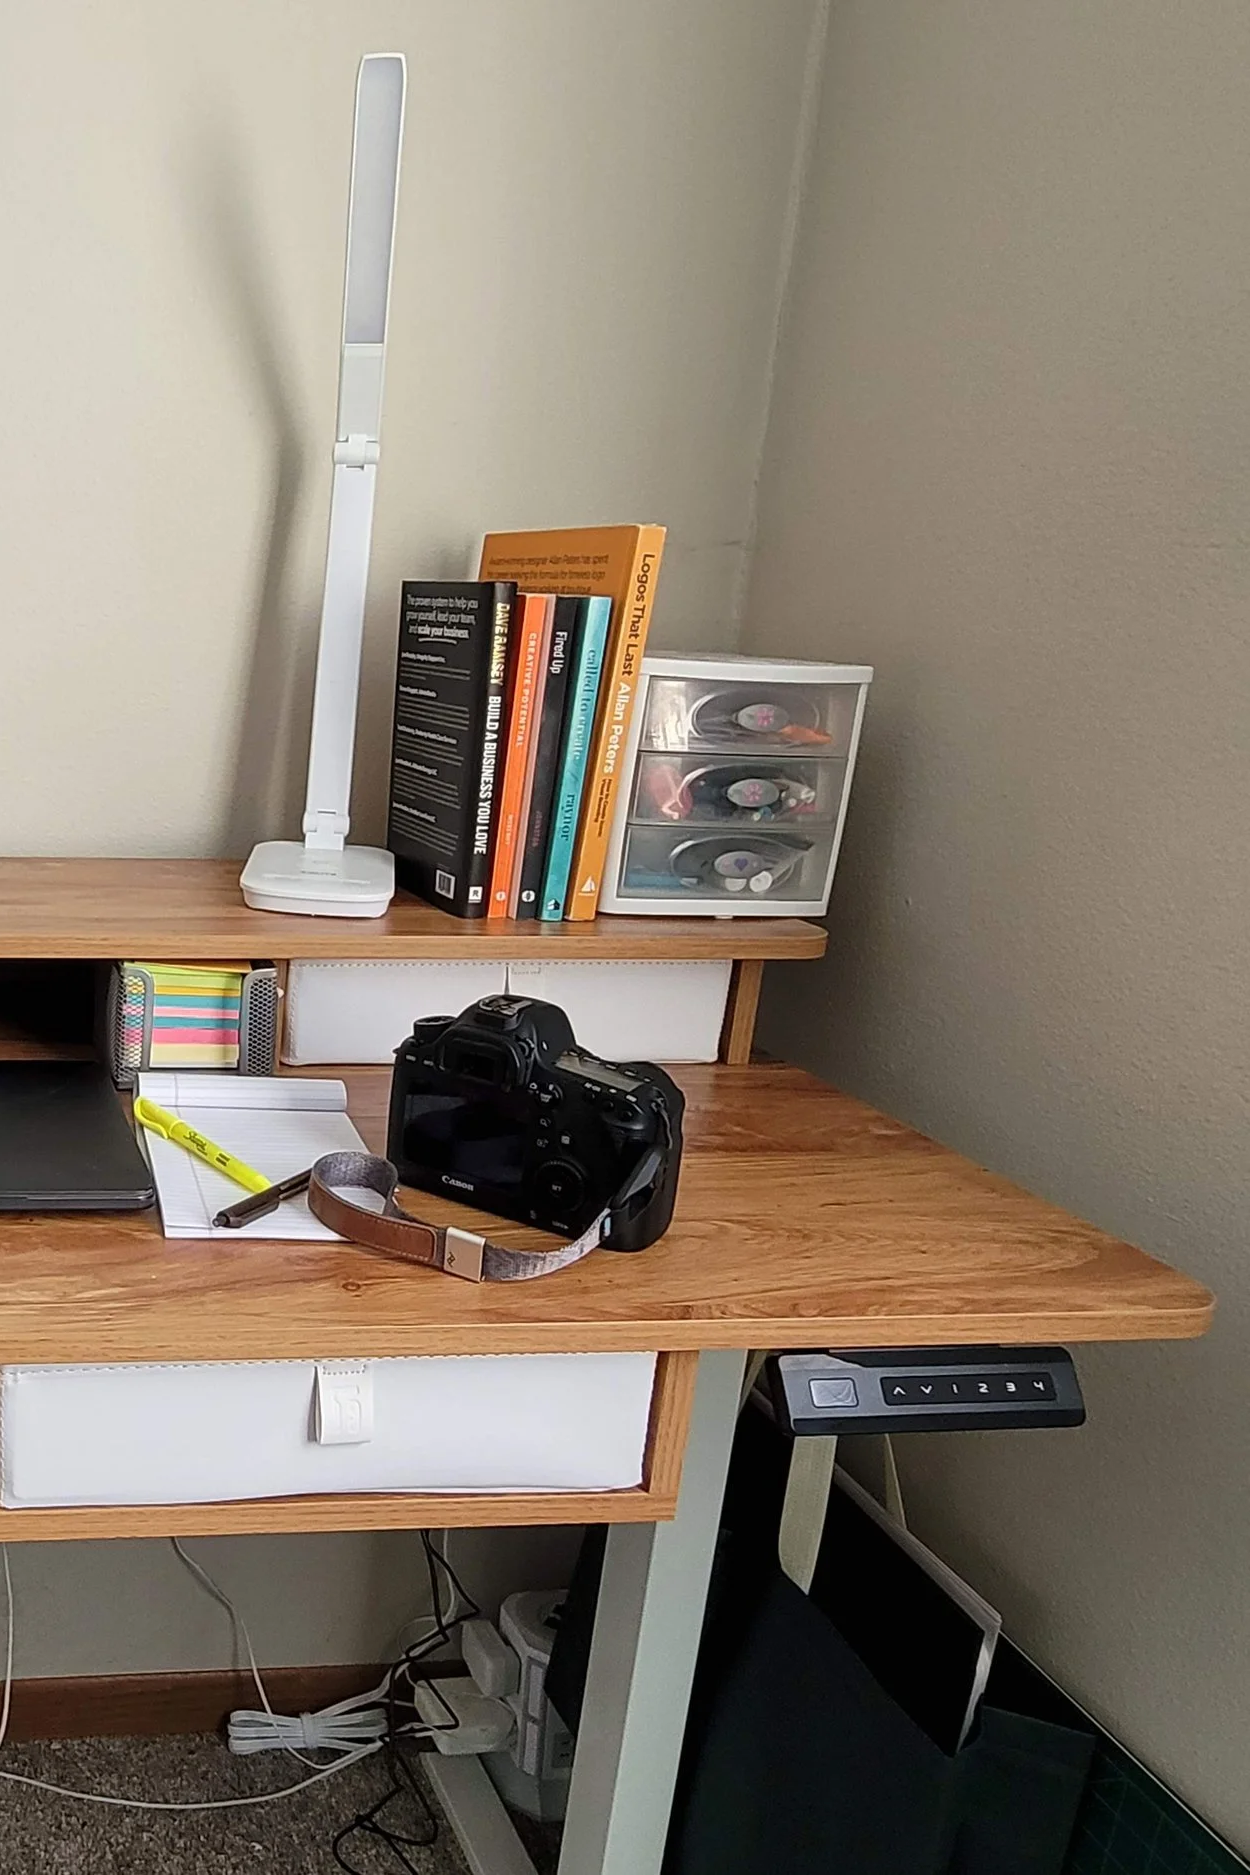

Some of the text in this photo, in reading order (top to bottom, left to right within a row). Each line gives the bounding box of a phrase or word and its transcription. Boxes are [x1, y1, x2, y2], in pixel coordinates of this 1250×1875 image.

[490, 602, 510, 686] DAVE RAMSEY
[550, 631, 567, 675] Fired Up
[622, 554, 655, 676] Logos That Last
[516, 633, 537, 747] CREATIVE POTENTIAL
[572, 650, 598, 761] called to create
[603, 682, 631, 775] Allan Peters
[474, 695, 502, 855] BUILD A BUSINESS YOU LOVE
[561, 793, 575, 841] raynor
[441, 1174, 475, 1193] Canon
[952, 1380, 1046, 1394] 1 2 3 4
